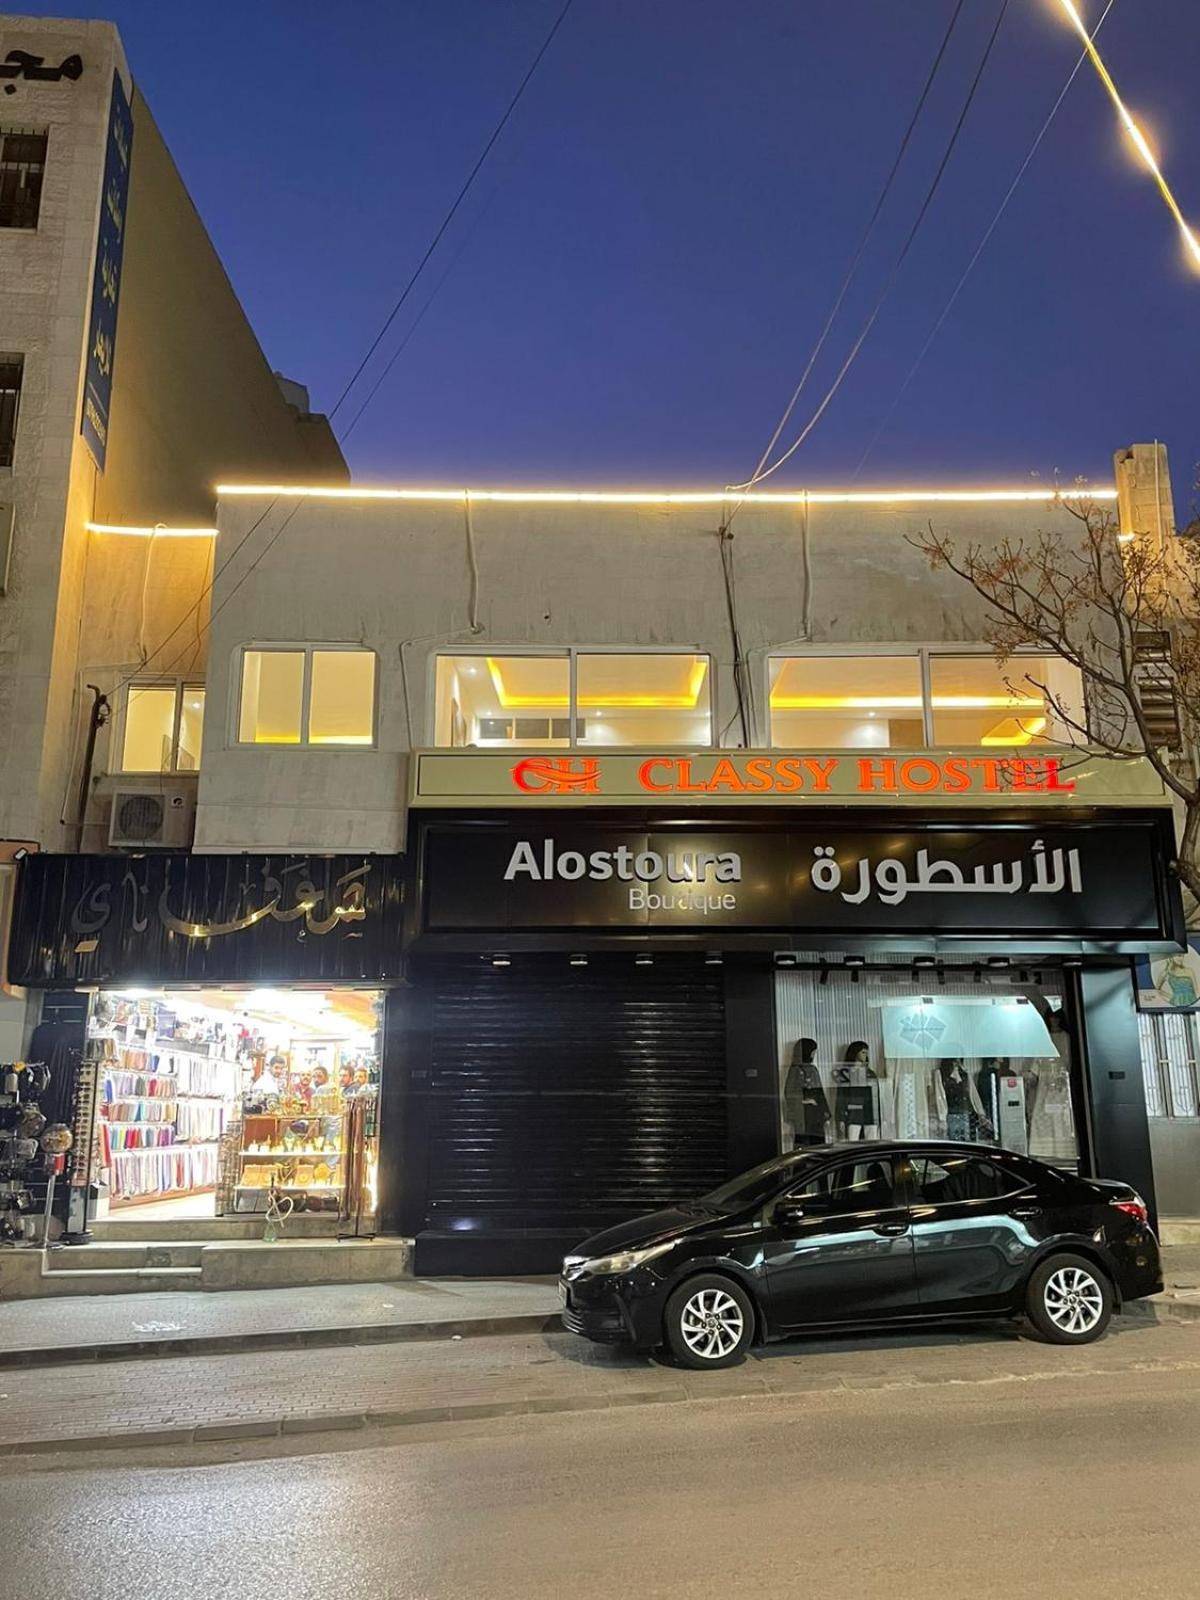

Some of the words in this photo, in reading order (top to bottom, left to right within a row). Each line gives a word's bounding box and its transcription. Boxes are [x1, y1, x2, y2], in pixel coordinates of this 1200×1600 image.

[509, 758, 602, 793] CH
[638, 758, 838, 792] CLASSY
[857, 757, 1076, 792] HOSTEL
[505, 839, 742, 882] Alostoura
[811, 840, 1082, 905] الأسطورة
[629, 888, 736, 915] Boutique
